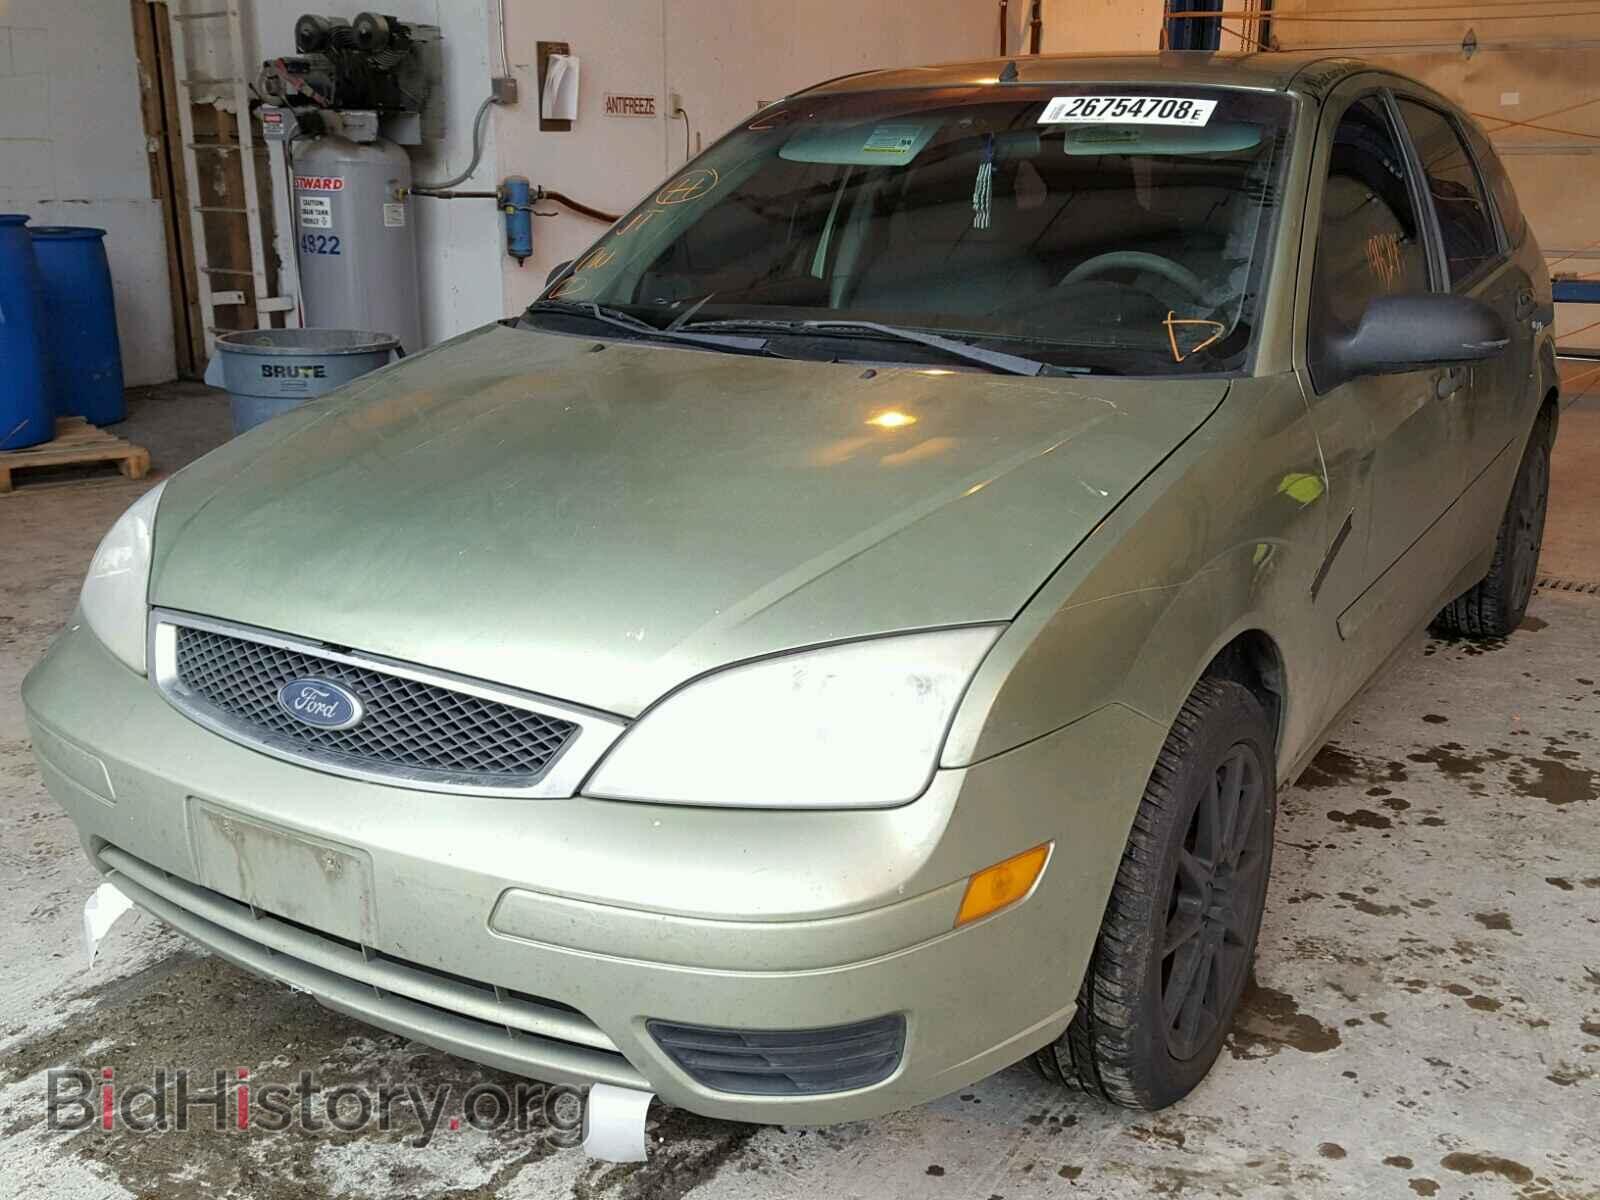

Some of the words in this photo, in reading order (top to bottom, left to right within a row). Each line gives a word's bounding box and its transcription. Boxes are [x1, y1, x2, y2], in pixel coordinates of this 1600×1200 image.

[606, 96, 656, 115] ANTIFREEZE
[1064, 98, 1194, 120] 26754708
[301, 233, 341, 256] 4822
[261, 364, 328, 379] BRUTE
[294, 686, 339, 718] Ford
